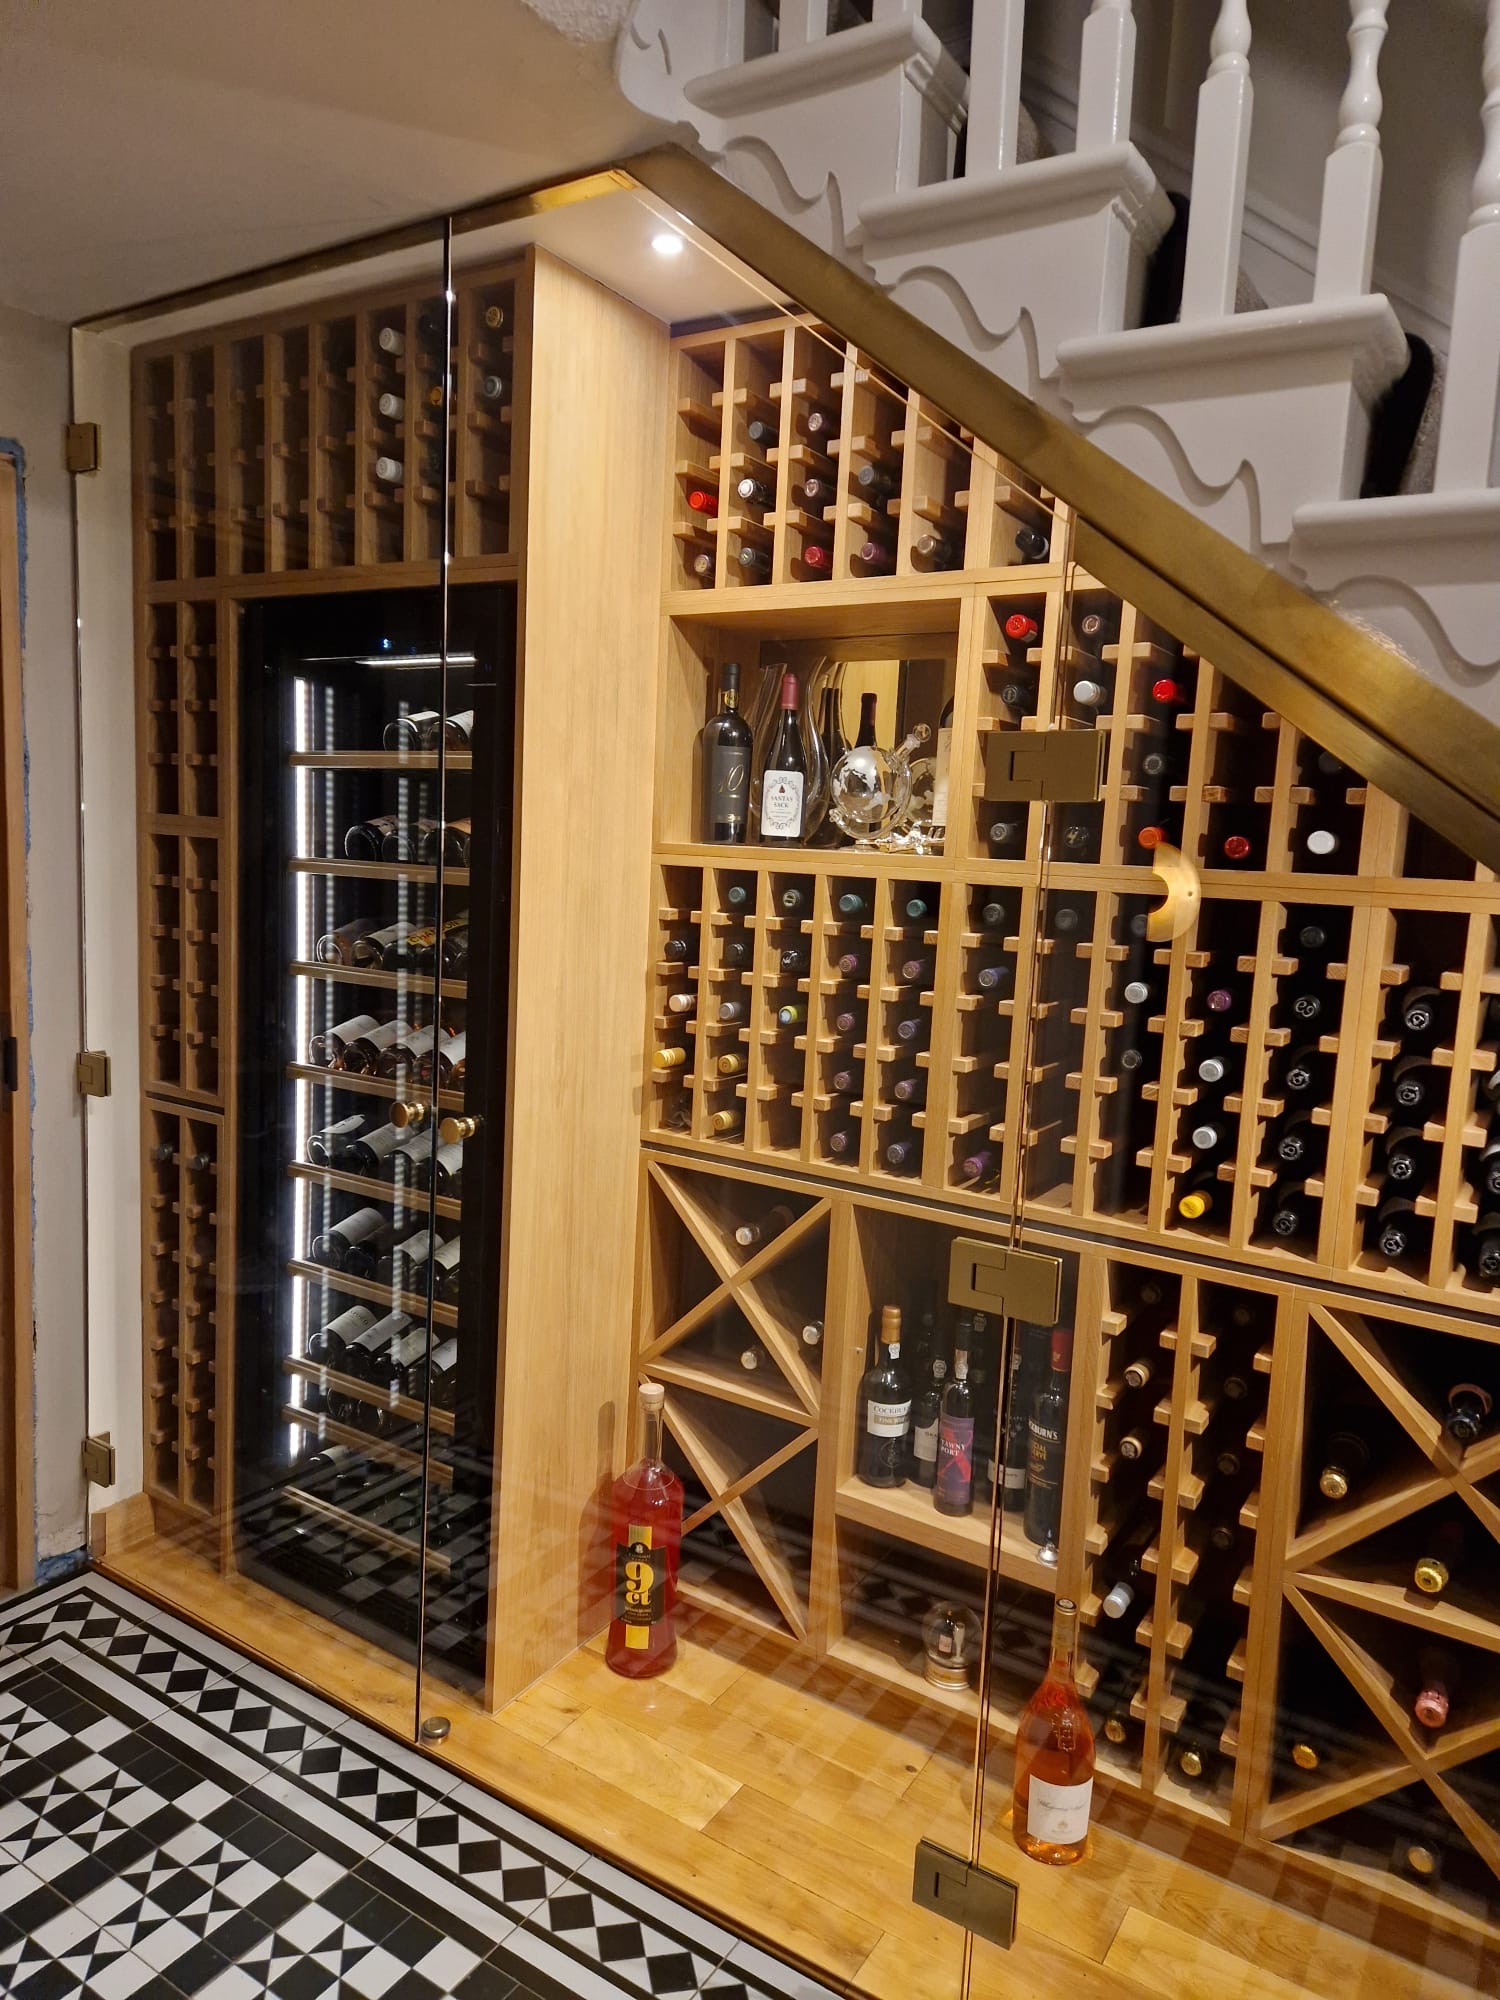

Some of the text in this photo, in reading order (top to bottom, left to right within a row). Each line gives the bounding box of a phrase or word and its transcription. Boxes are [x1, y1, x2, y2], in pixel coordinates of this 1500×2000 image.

[940, 1446, 960, 1457] PORT
[941, 1438, 966, 1452] TAWNY
[625, 1561, 654, 1593] 9
